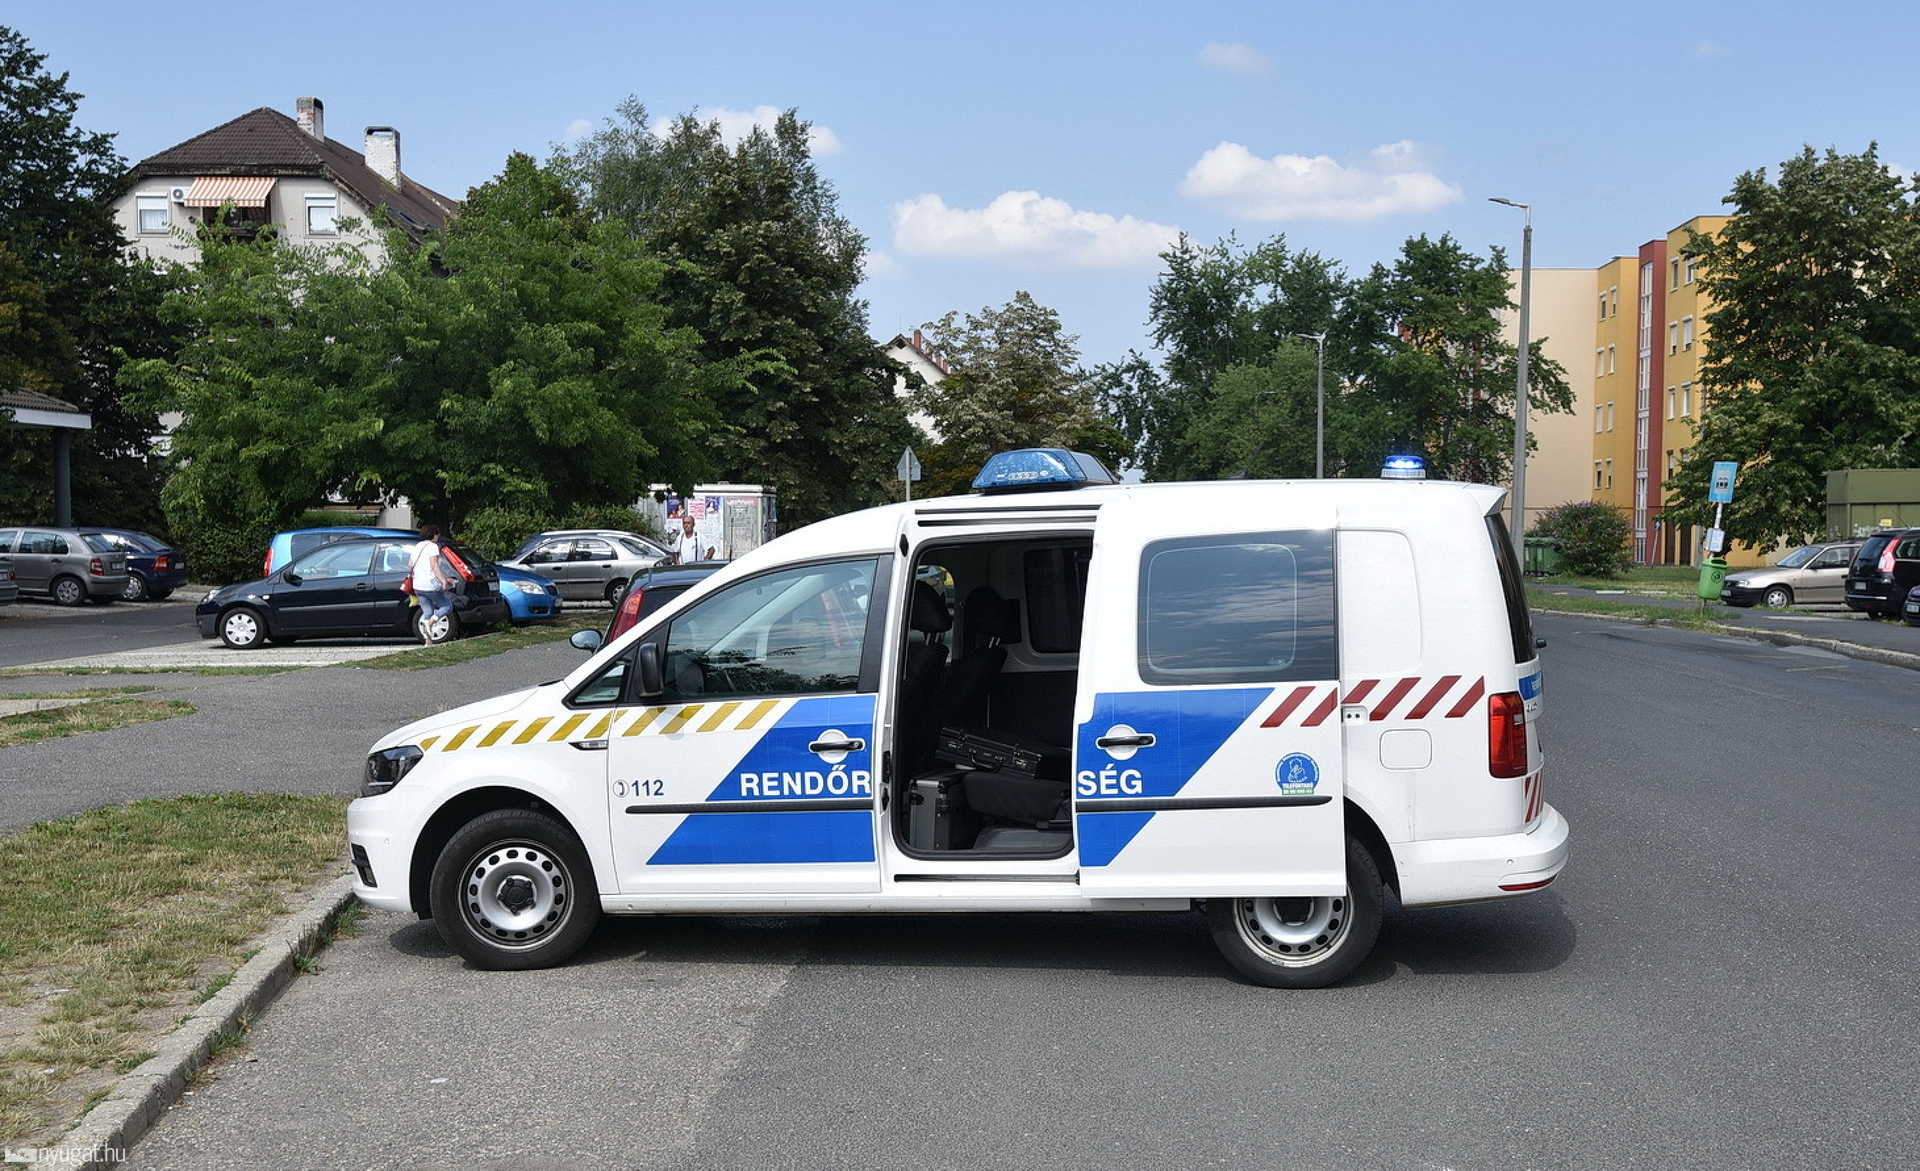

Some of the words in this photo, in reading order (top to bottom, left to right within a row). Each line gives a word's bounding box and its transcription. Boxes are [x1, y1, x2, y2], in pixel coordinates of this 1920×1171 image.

[631, 779, 664, 796] 112
[740, 764, 871, 797] RENDŐR
[1077, 763, 1143, 796] SÉG
